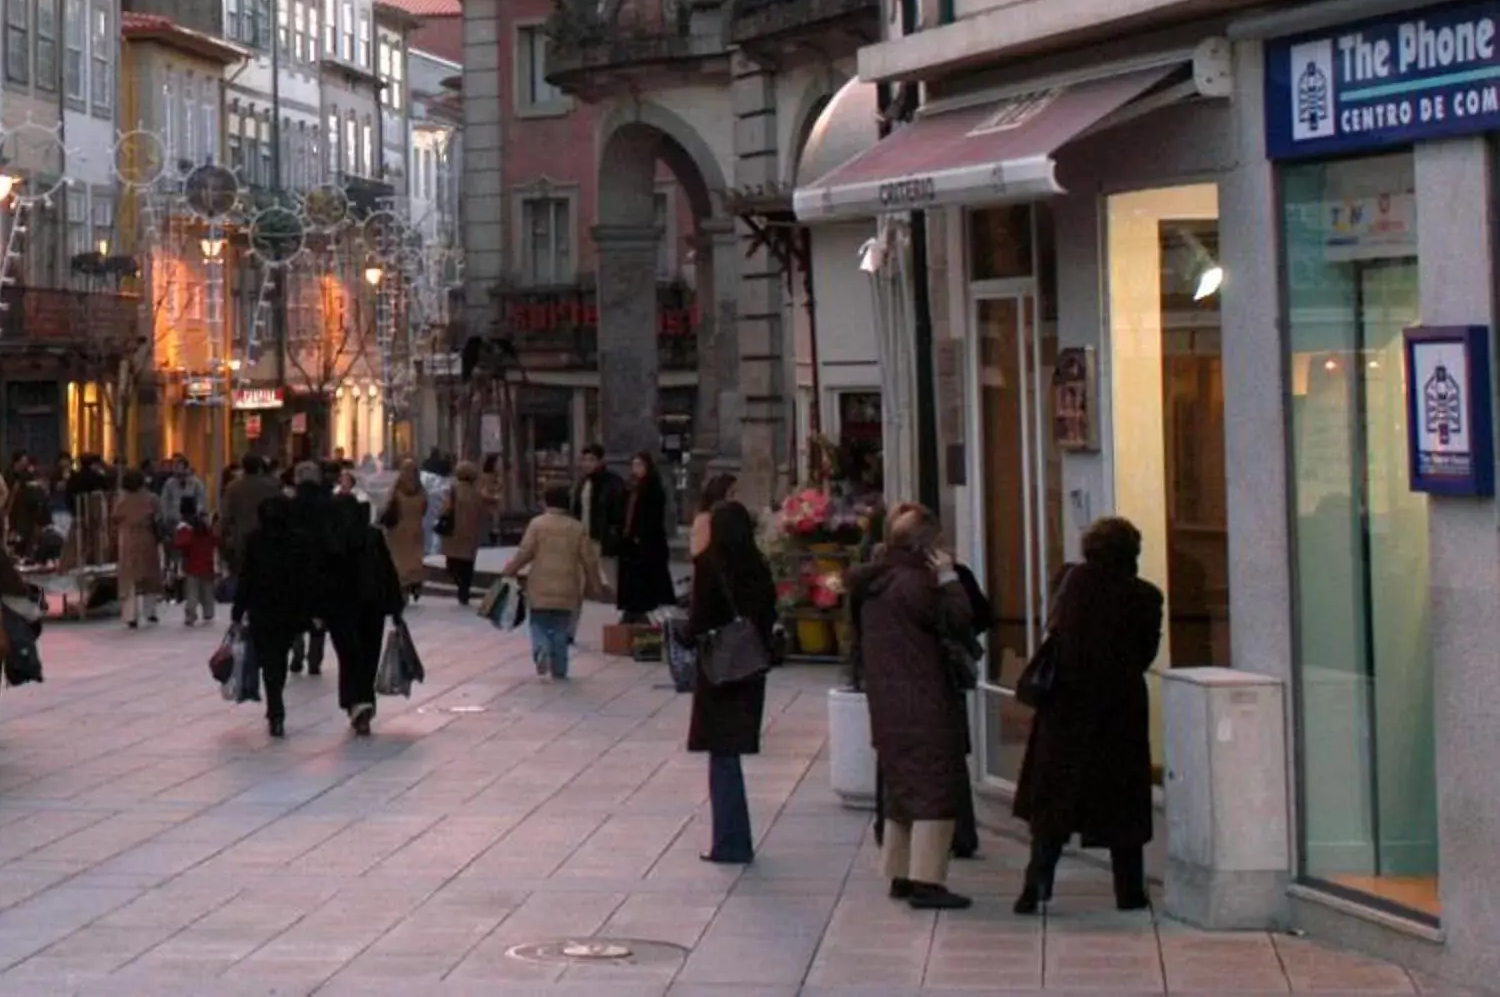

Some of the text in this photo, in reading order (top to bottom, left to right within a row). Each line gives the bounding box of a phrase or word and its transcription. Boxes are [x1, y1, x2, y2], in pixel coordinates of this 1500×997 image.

[1337, 17, 1496, 83] The Phone
[1340, 100, 1413, 133] CENTRO
[1419, 94, 1445, 122] DE
